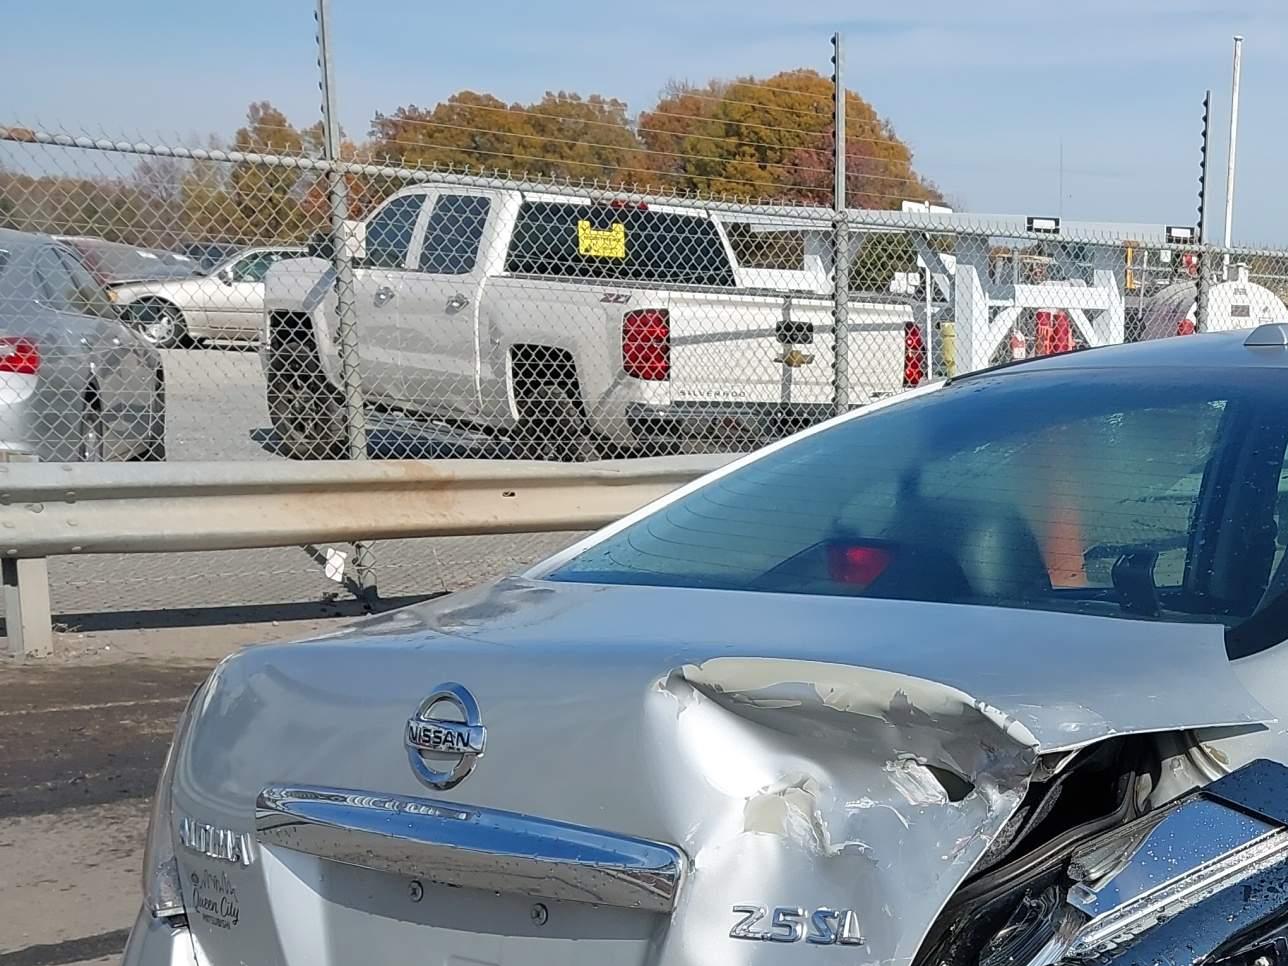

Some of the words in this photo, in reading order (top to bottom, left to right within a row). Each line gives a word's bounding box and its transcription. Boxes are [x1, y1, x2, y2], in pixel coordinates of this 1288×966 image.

[408, 725, 471, 748] NISSAN
[192, 886, 219, 914] Queen
[220, 896, 240, 926] City
